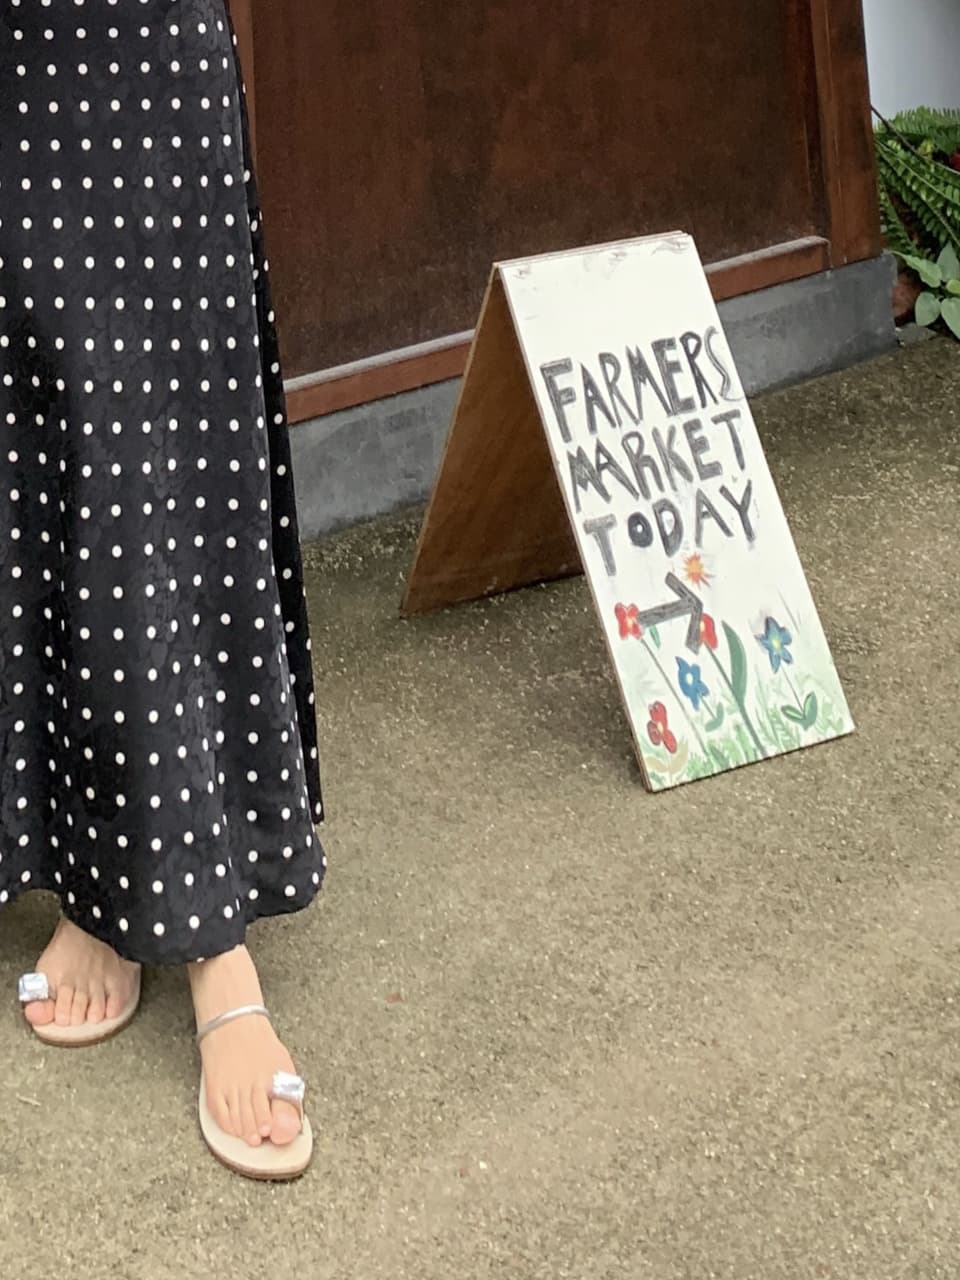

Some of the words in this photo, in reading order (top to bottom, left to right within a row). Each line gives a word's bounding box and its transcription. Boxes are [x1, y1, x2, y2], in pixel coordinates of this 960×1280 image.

[540, 325, 744, 443] FARMERS
[567, 409, 746, 514] MARKET
[582, 479, 756, 577] TODAY
